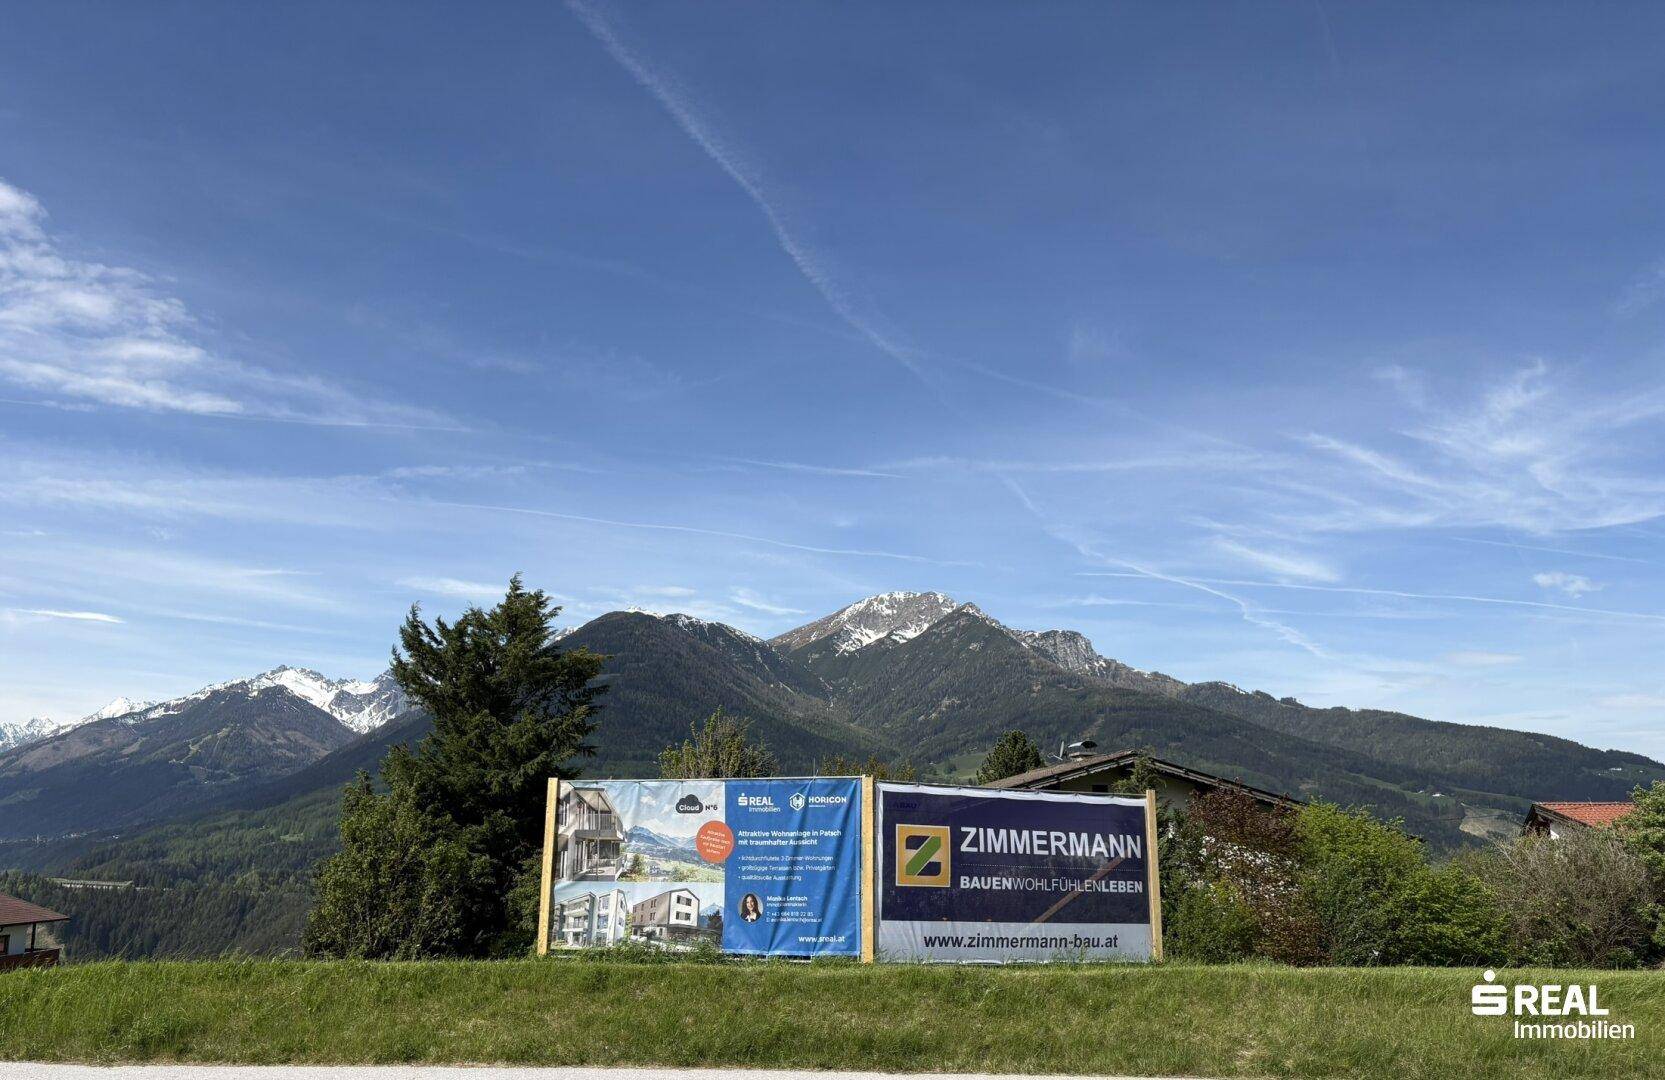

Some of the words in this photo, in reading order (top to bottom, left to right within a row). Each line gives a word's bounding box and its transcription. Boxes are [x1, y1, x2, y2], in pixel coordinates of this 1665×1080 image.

[749, 797, 774, 806] REAL
[770, 830, 810, 838] Wohnanlage
[960, 827, 1142, 859] ZIMMERMANN
[960, 875, 1143, 894] BAUENWOHLFÜHLENLEBEN
[924, 933, 1118, 949] www.zimmermann-bau.at
